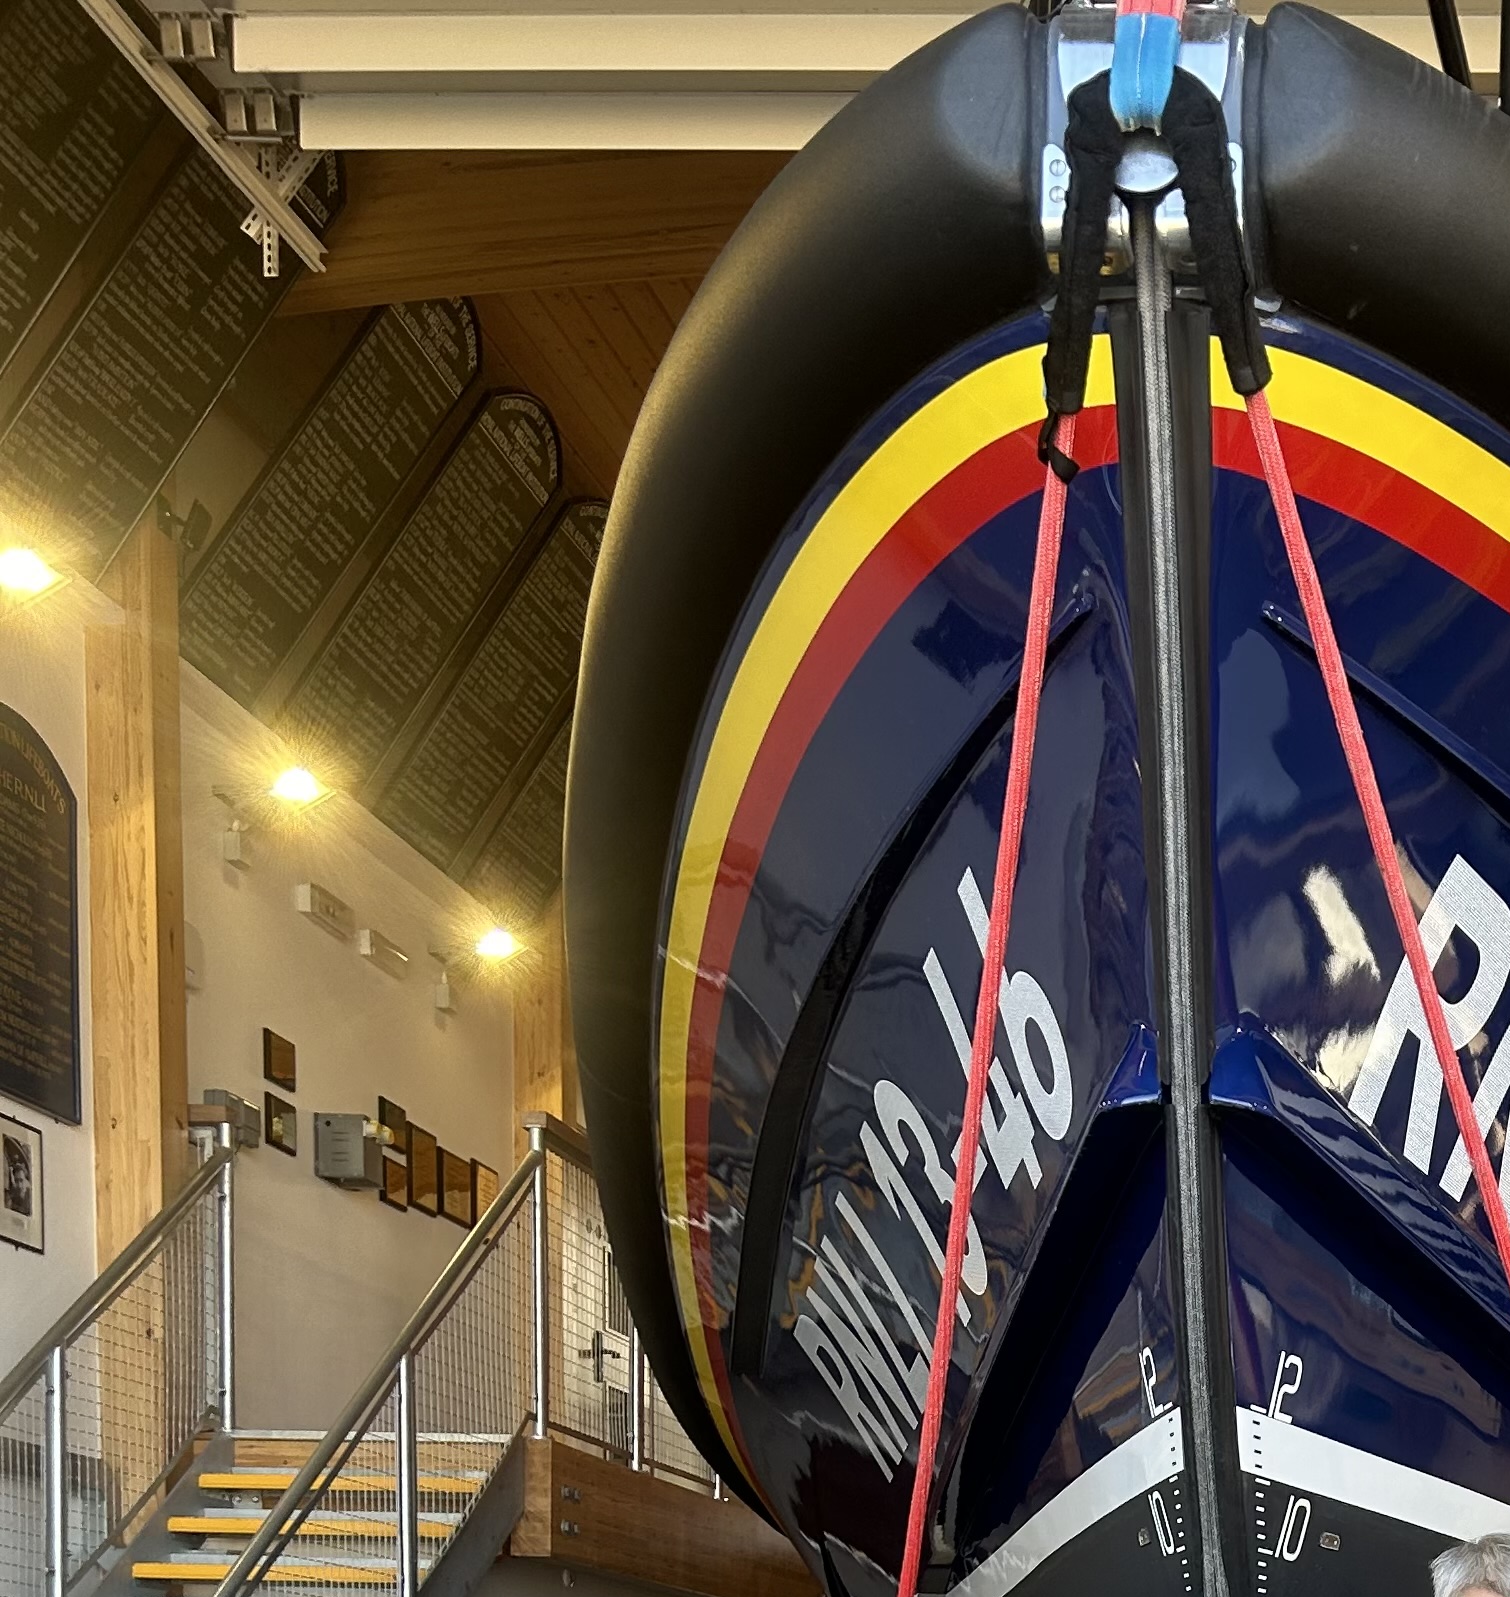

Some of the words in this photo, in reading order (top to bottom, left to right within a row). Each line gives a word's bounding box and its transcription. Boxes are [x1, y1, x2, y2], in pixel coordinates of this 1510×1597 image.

[794, 1191, 933, 1482] RNLI
[1139, 1347, 1164, 1418] 12
[1268, 1351, 1303, 1423] 12
[1148, 1490, 1175, 1557] 10
[1274, 1494, 1312, 1562] 10
